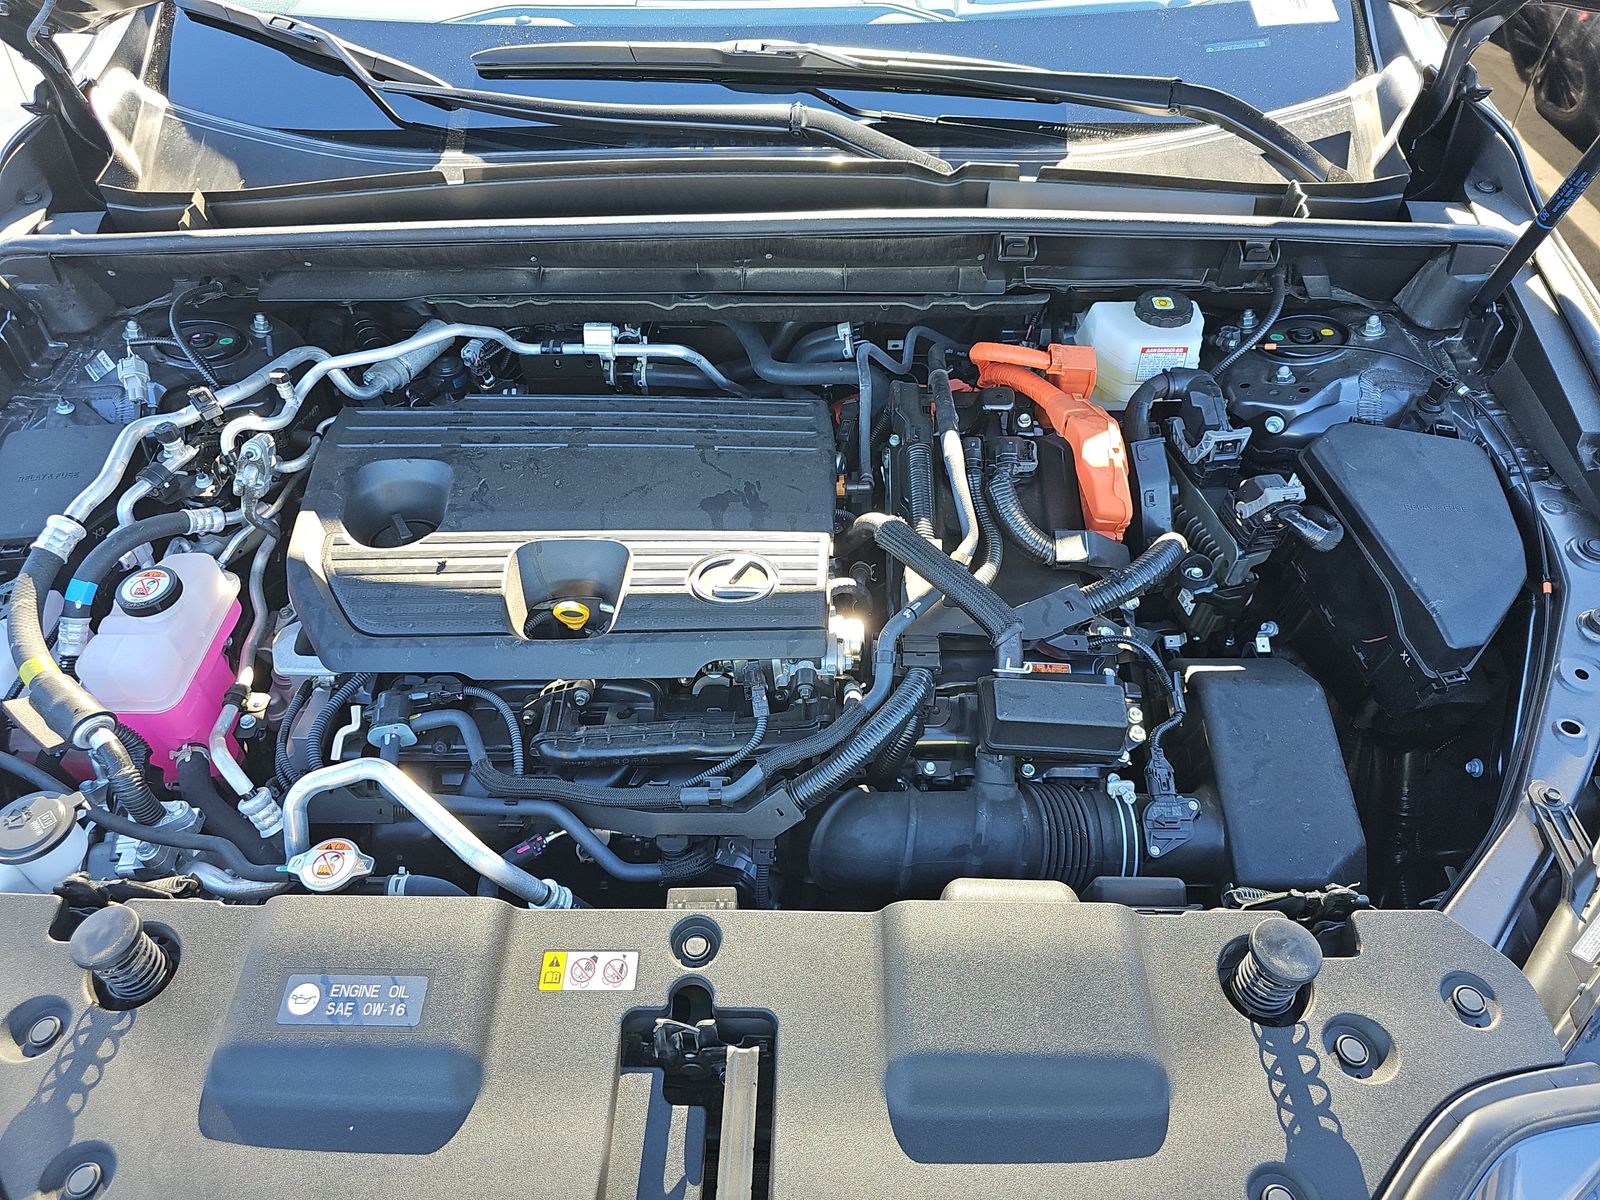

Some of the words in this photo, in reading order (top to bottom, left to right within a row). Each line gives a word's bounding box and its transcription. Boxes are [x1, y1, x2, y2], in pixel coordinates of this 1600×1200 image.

[330, 984, 381, 998] ENGINE
[389, 985, 410, 998] OIL
[326, 1002, 355, 1016] SAE
